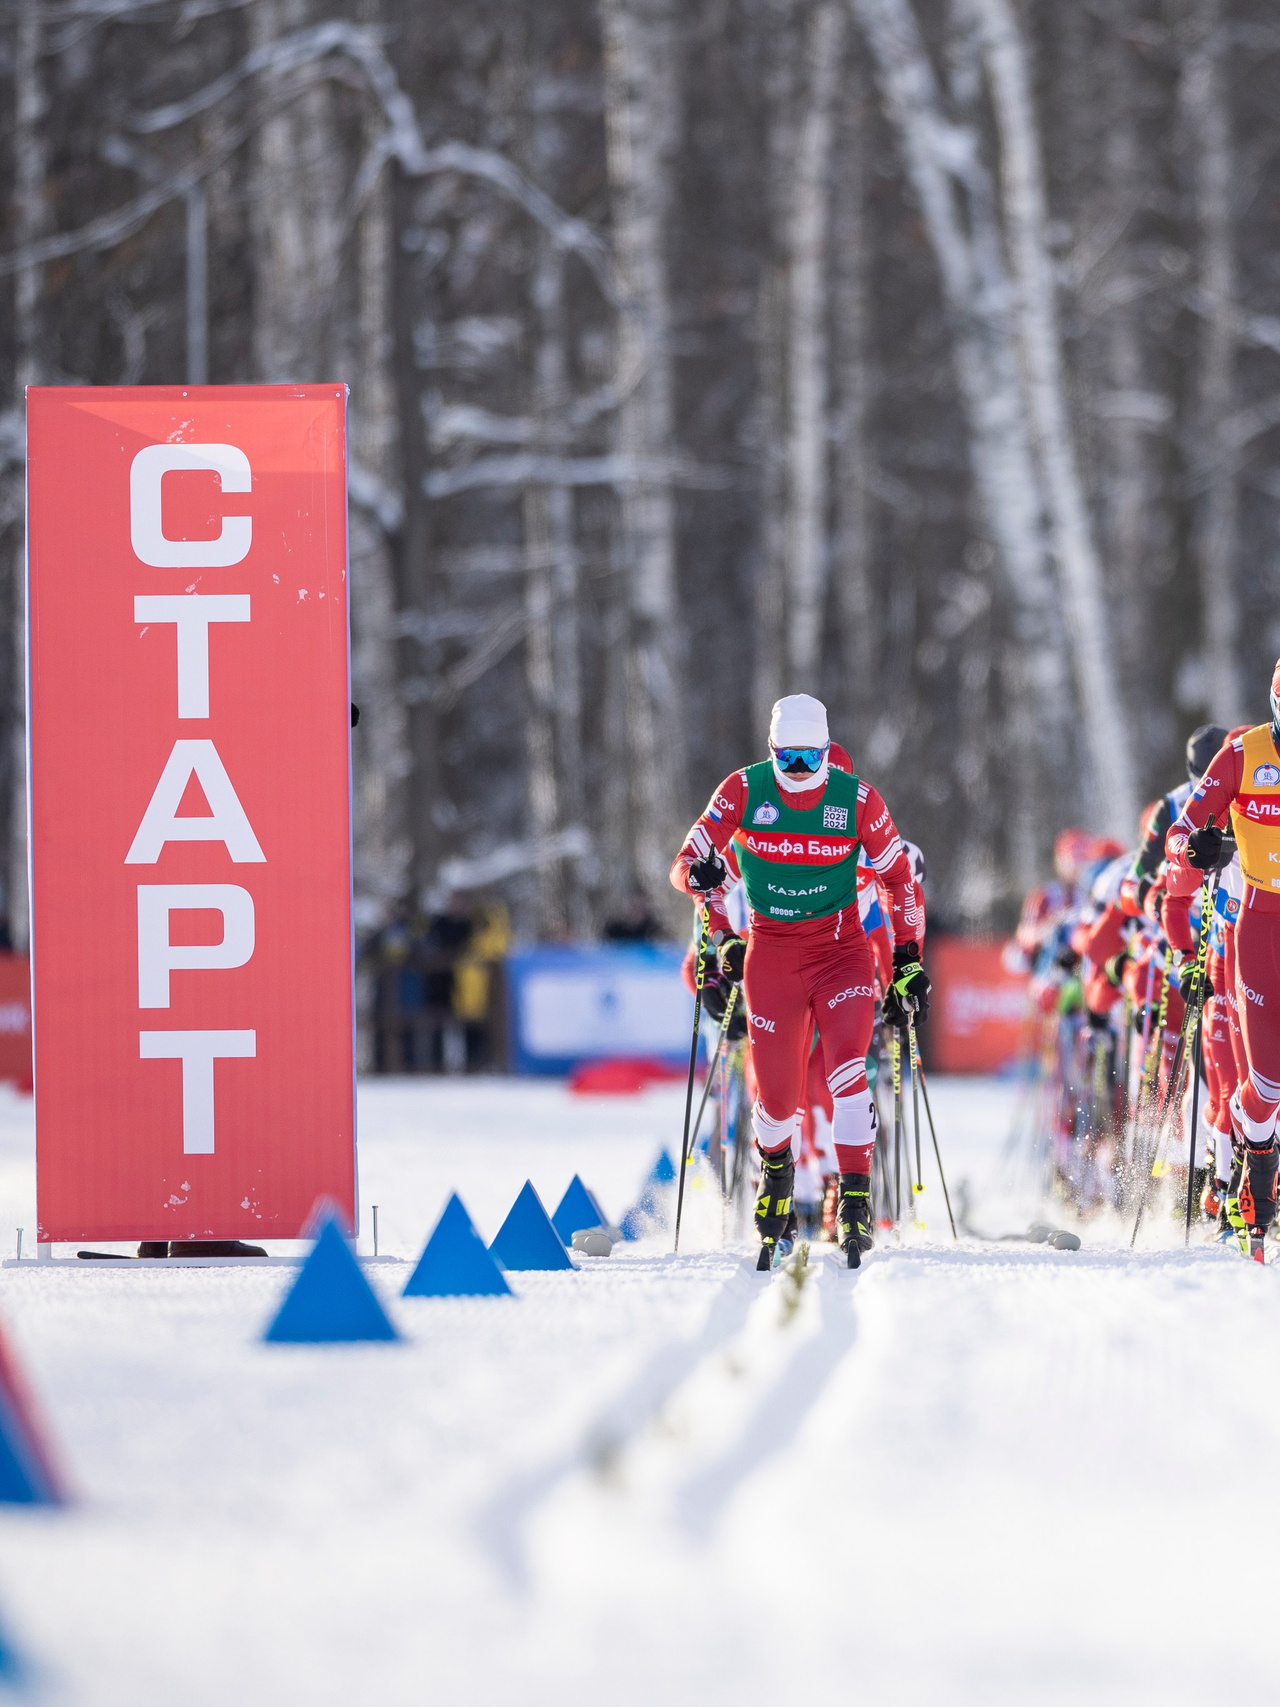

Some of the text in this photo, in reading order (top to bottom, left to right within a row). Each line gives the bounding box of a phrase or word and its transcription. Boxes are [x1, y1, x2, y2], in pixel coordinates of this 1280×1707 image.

[124, 443, 268, 1155] СТАРТ
[824, 806, 847, 815] СЕЗОН
[824, 813, 847, 822] 2023
[824, 820, 847, 830] 2024
[746, 836, 852, 857] Альфа Банк
[767, 883, 828, 897] КАЗАНЬ
[827, 985, 872, 1010] BOSCO
[869, 1102, 877, 1130] 2
